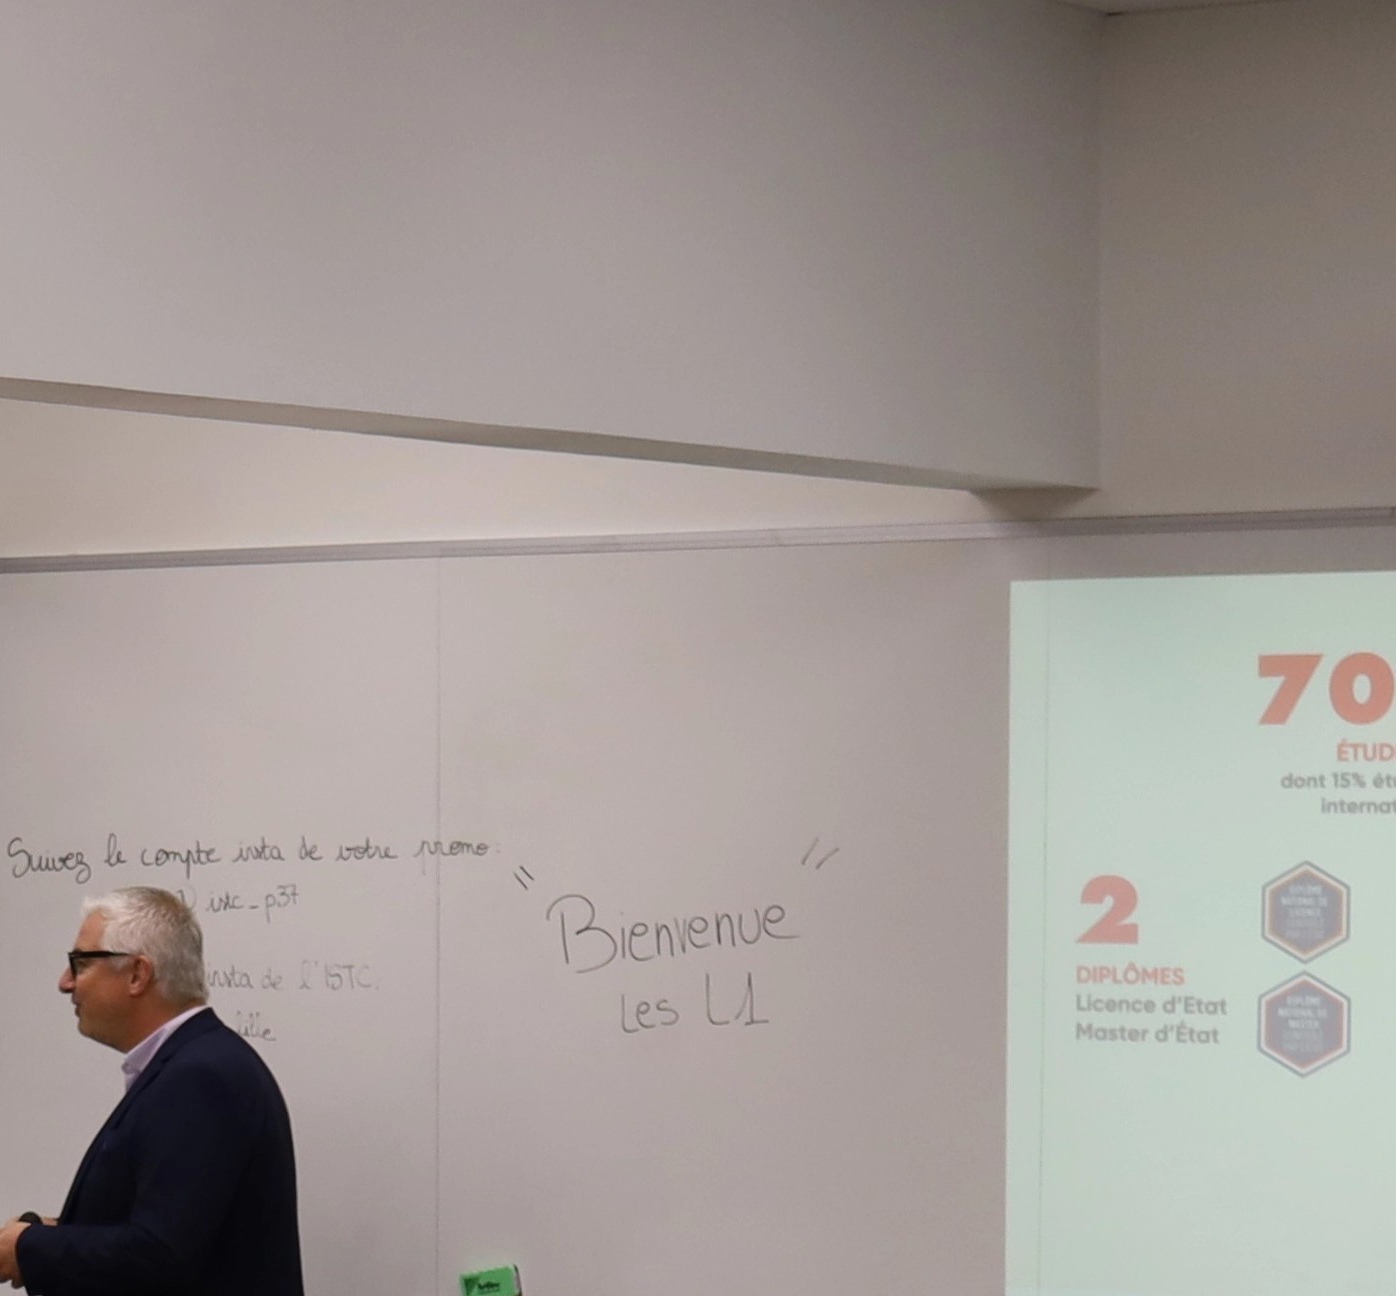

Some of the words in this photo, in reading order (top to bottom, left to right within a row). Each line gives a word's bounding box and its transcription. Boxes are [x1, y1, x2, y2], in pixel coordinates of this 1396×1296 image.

[1337, 738, 1396, 762] ÉTUD
[1280, 772, 1326, 789] dont
[1331, 772, 1367, 789] 15%
[8, 836, 91, 883] Suivez
[104, 833, 127, 868] le
[140, 841, 221, 879] compte
[232, 840, 285, 864] insta
[299, 836, 323, 862] de
[335, 841, 398, 864] votre
[1075, 874, 1139, 945] 2
[545, 894, 801, 974] Bienvenue
[261, 969, 283, 990] de
[1075, 962, 1185, 986] DIPLÔMES
[705, 972, 769, 1027] L1
[1075, 994, 1157, 1015] Licence
[1163, 994, 1227, 1016] d'Etat
[1075, 1022, 1148, 1043] Master
[1154, 1022, 1220, 1045] d'État
